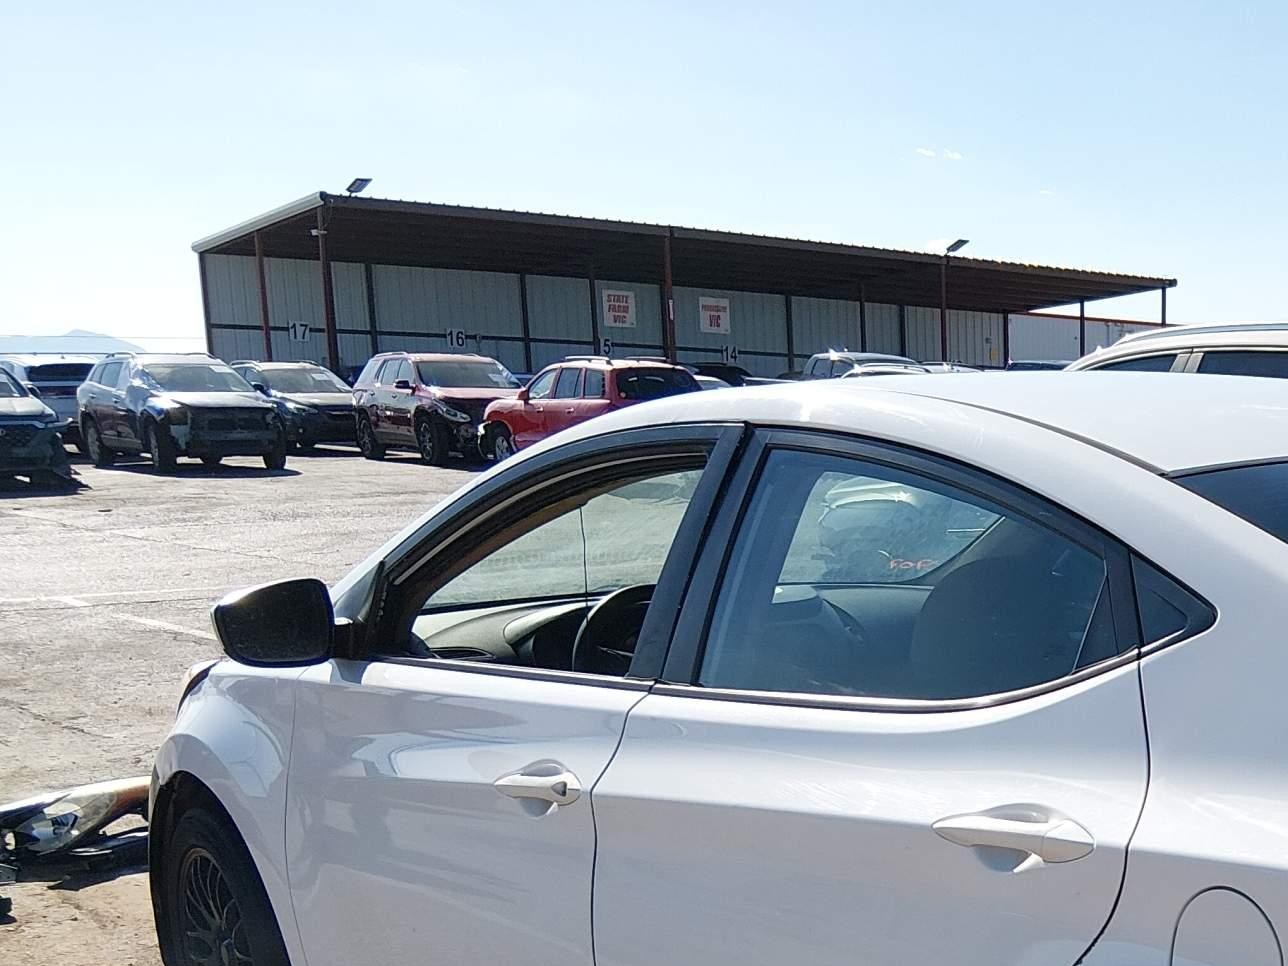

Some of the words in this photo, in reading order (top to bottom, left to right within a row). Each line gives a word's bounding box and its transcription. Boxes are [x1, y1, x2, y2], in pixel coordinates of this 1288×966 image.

[709, 313, 722, 328] VIC
[290, 322, 309, 340] 17
[447, 329, 465, 347] 16
[603, 338, 611, 355] 5
[723, 344, 738, 363] 14
